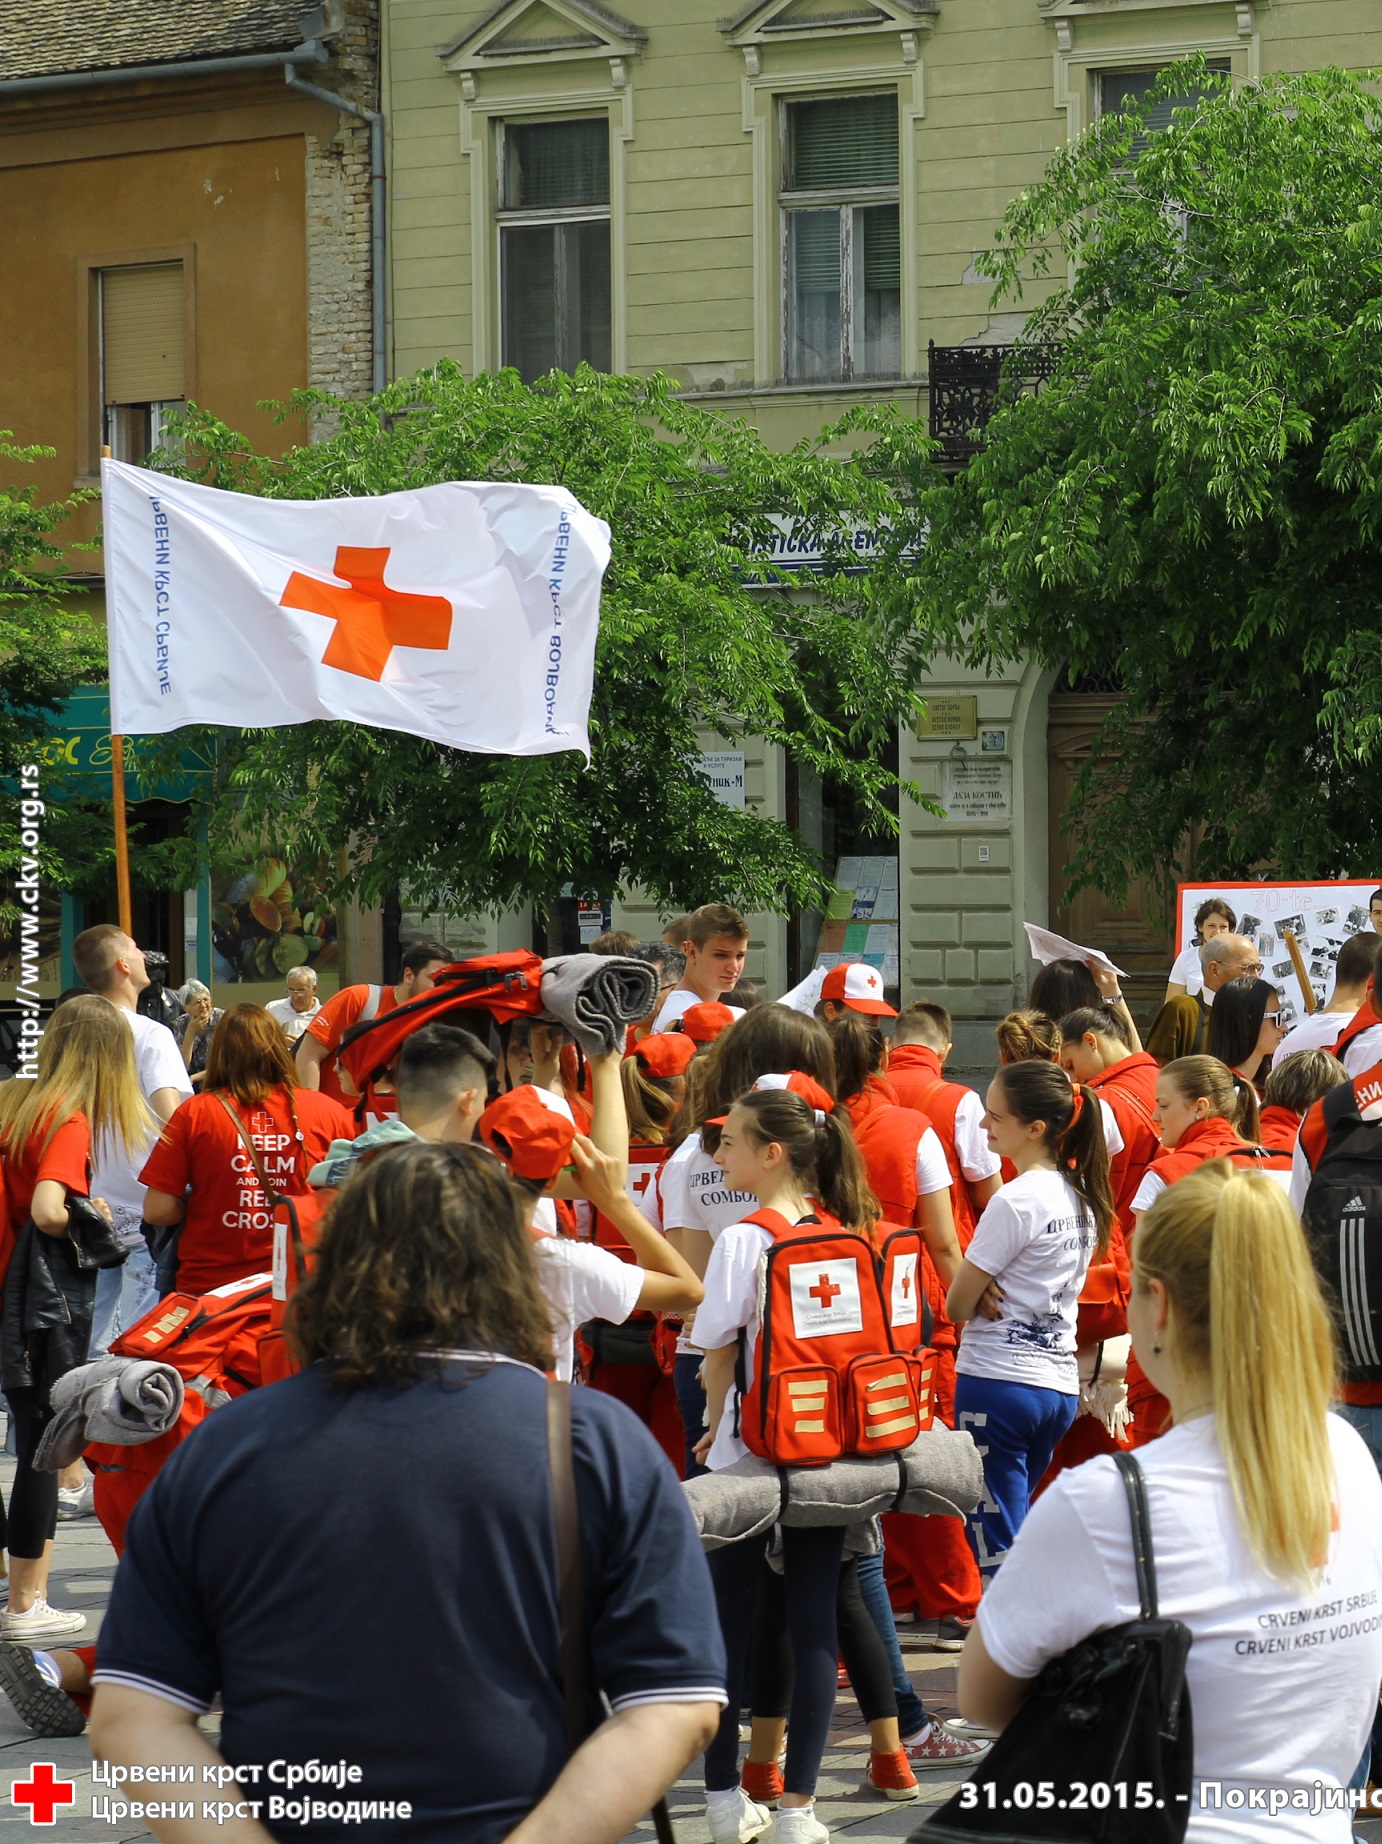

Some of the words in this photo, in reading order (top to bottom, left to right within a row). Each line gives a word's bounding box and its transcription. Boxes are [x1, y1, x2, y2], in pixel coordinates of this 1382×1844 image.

[236, 1177, 259, 1186] AND
[1342, 1204, 1366, 1213] adidas
[1258, 1608, 1313, 1630] CRVENI
[1313, 1599, 1345, 1620] KRST
[1235, 1636, 1291, 1656] CRVENI
[1294, 1630, 1327, 1649] KRST
